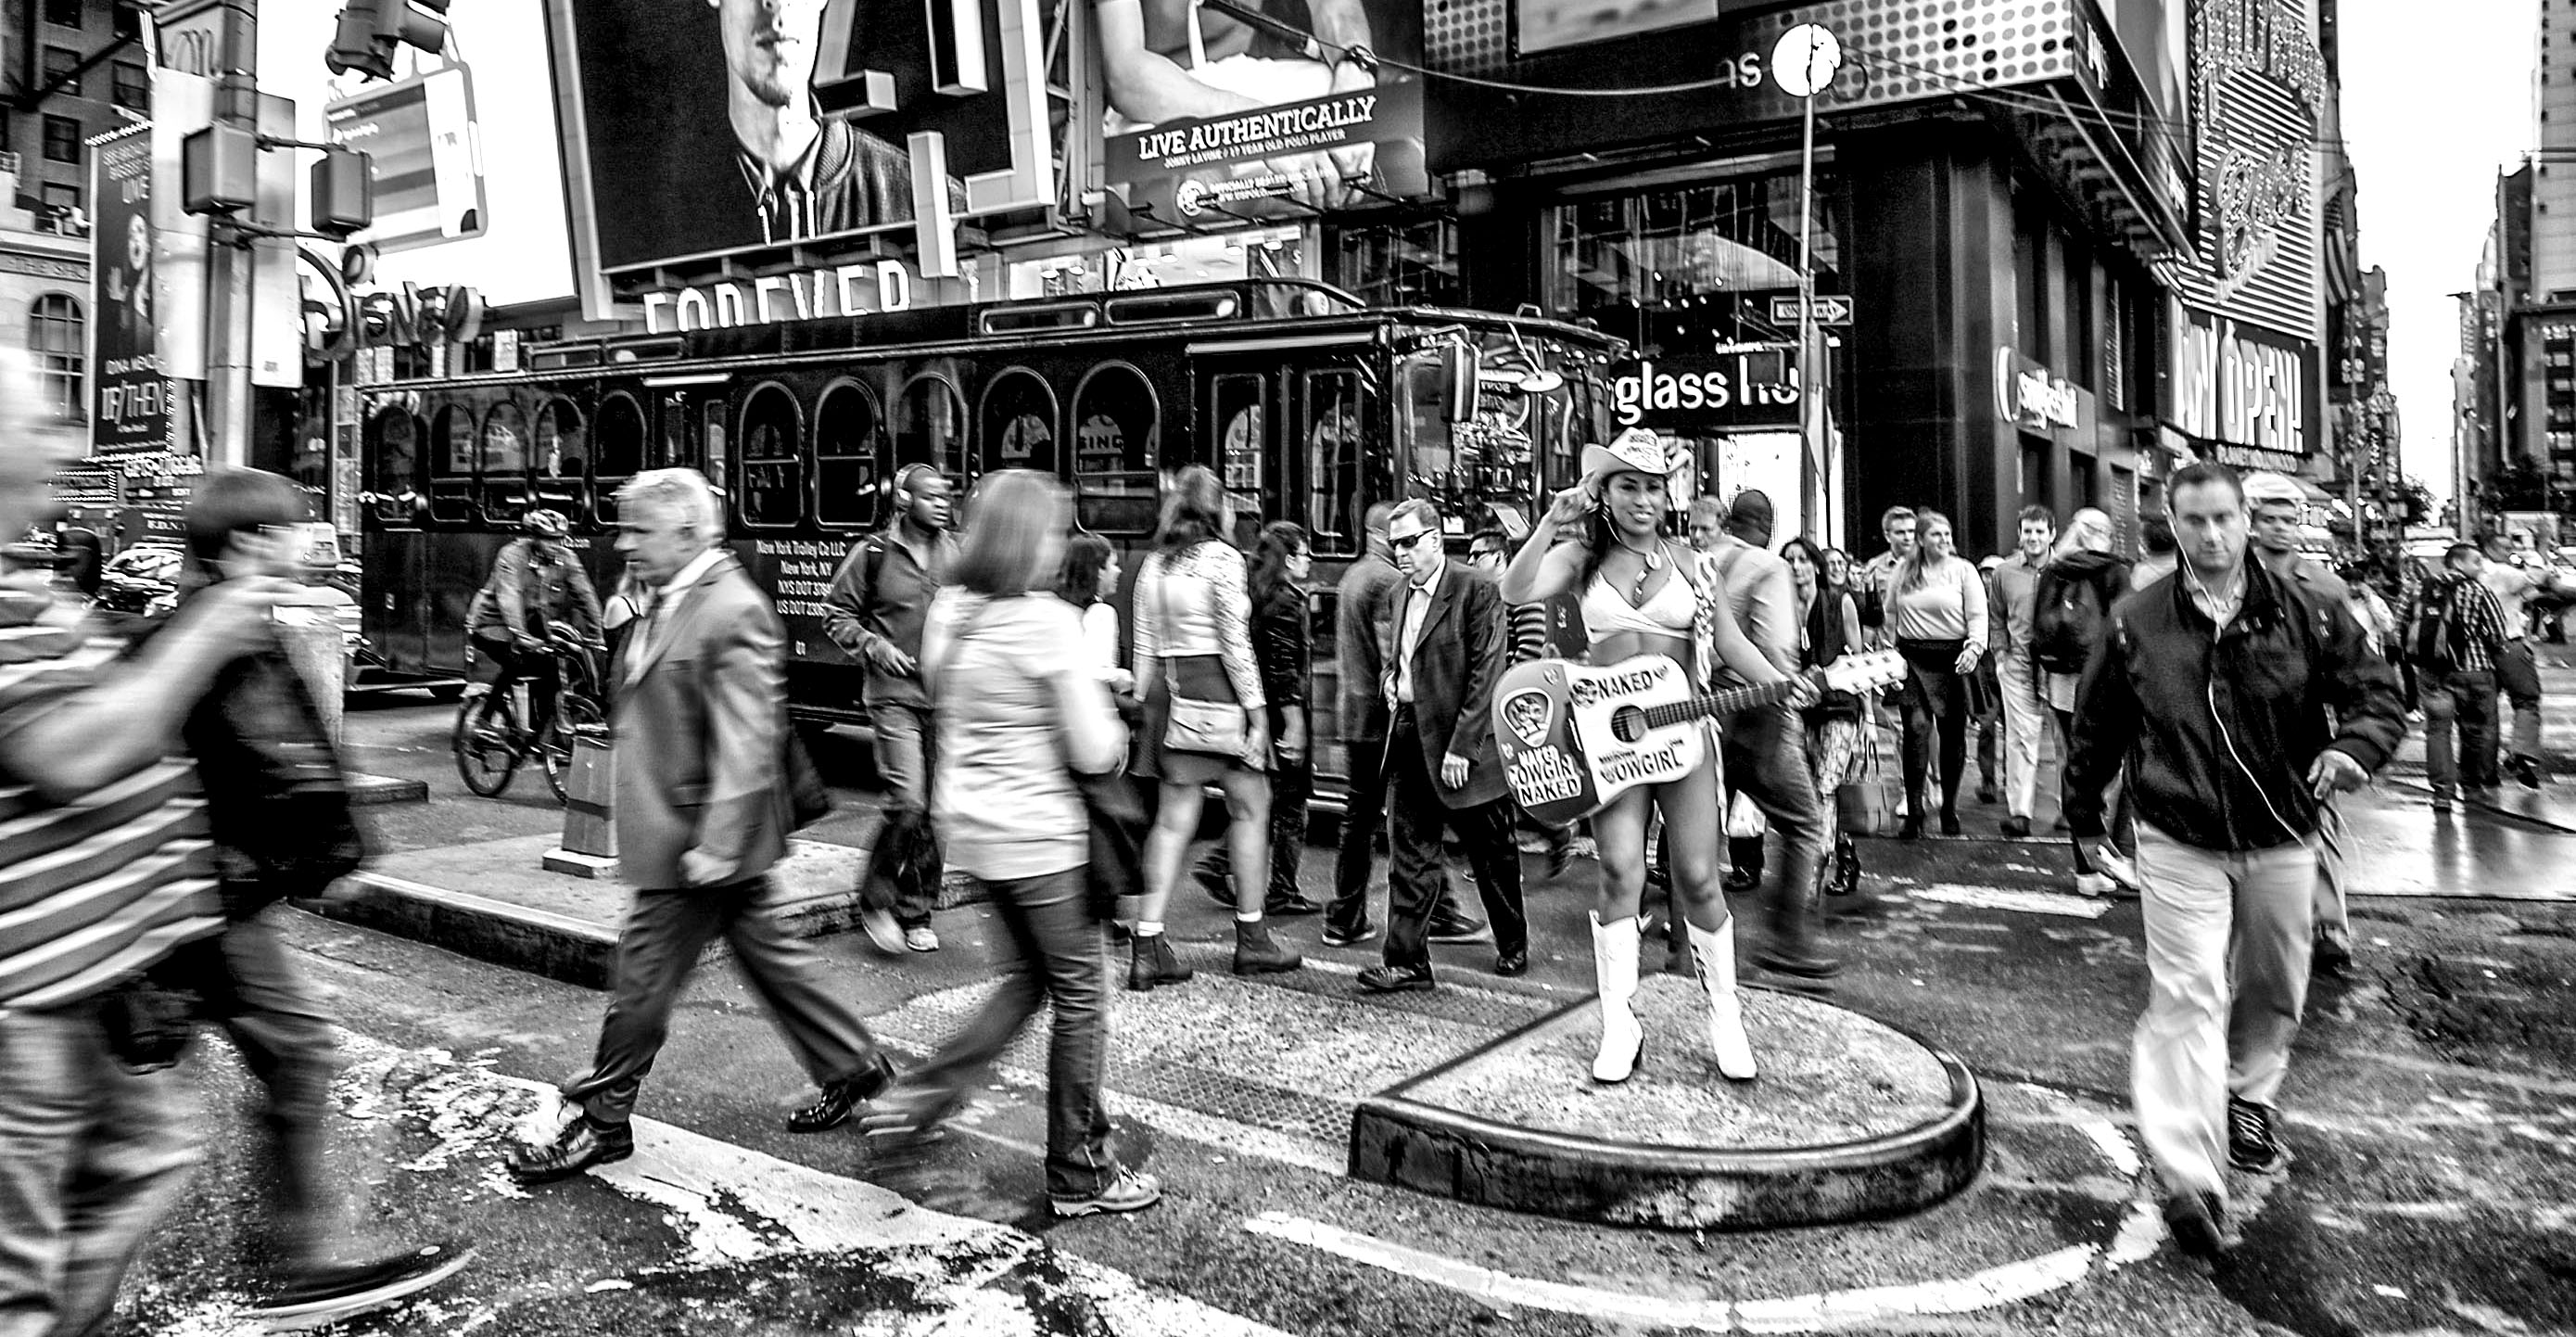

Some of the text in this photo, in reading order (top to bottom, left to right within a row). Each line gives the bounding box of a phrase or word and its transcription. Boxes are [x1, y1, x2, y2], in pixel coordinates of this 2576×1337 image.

[1138, 95, 1377, 160] LIVE AUTHENTICALLY
[1240, 142, 1265, 156] YEAR
[1265, 139, 1283, 152] OLD
[1284, 134, 1309, 148] POLO
[1309, 129, 1346, 145] PLAYER
[643, 261, 910, 335] FOREVER
[756, 539, 775, 555] New
[775, 539, 793, 555] York
[792, 540, 818, 559] Trolley
[830, 541, 846, 557] LLC
[780, 559, 799, 575] New
[819, 560, 833, 577] NY
[778, 579, 795, 595] NYS
[795, 579, 812, 596] DOT
[776, 599, 789, 615] US
[789, 599, 806, 615] DOT
[1595, 669, 1654, 700] NAKED
[1518, 779, 1580, 806] NAKED
